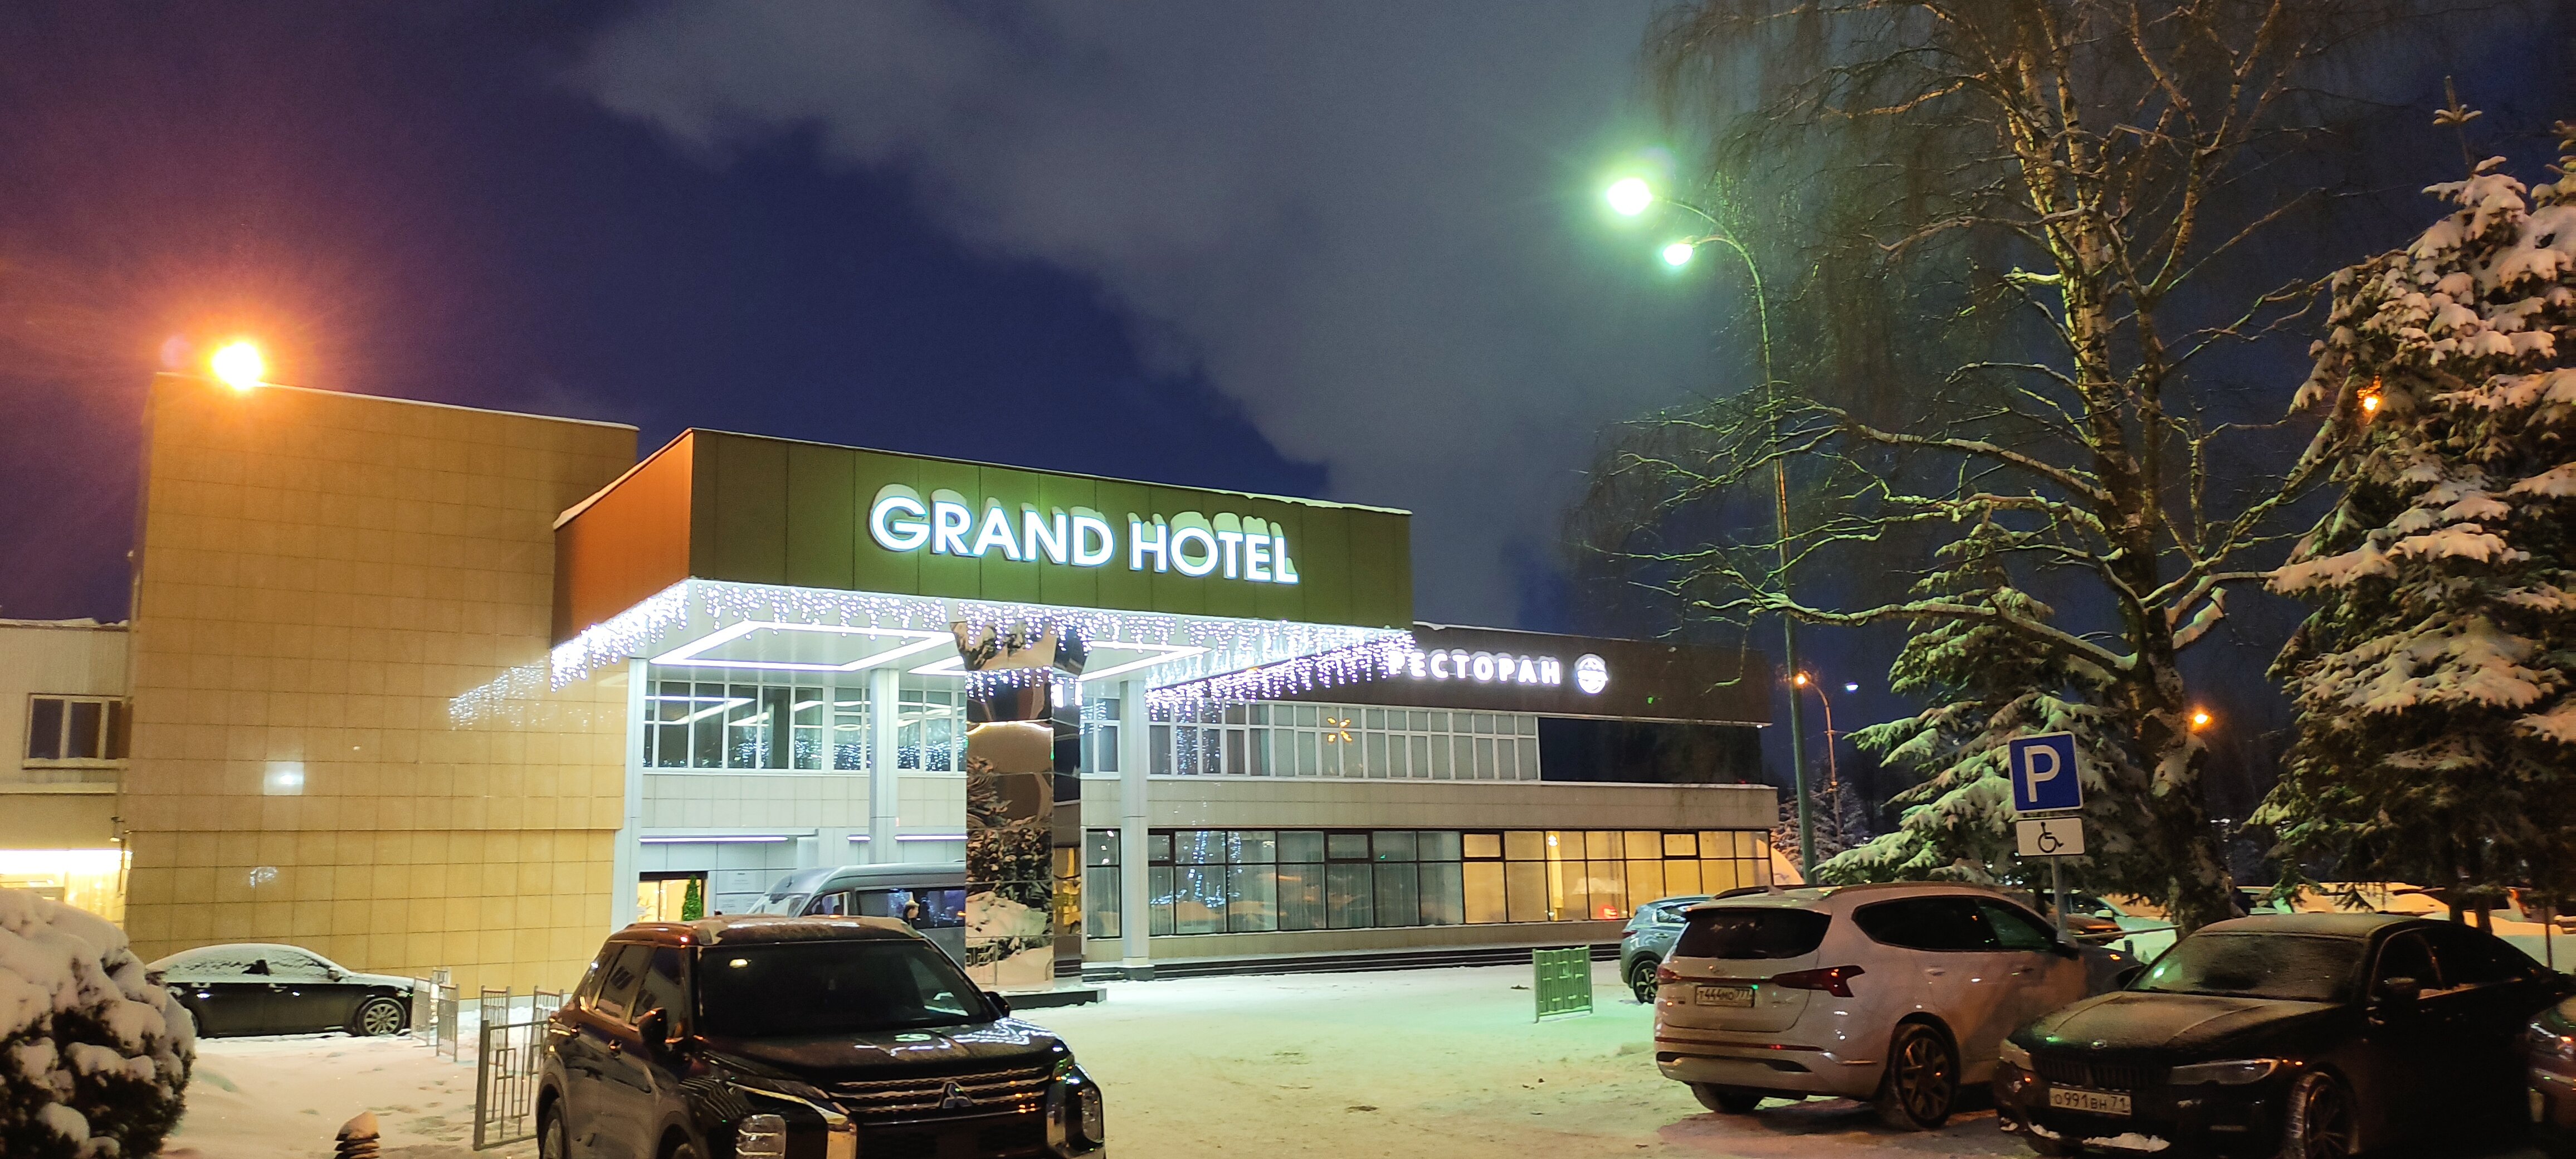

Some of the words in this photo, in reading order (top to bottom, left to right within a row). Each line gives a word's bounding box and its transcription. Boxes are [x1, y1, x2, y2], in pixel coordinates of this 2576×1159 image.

[871, 495, 1114, 566] GRAND
[1130, 522, 1299, 583] HOTEL
[1388, 650, 1562, 685] РЕСТОРАН
[2024, 744, 2060, 802] P
